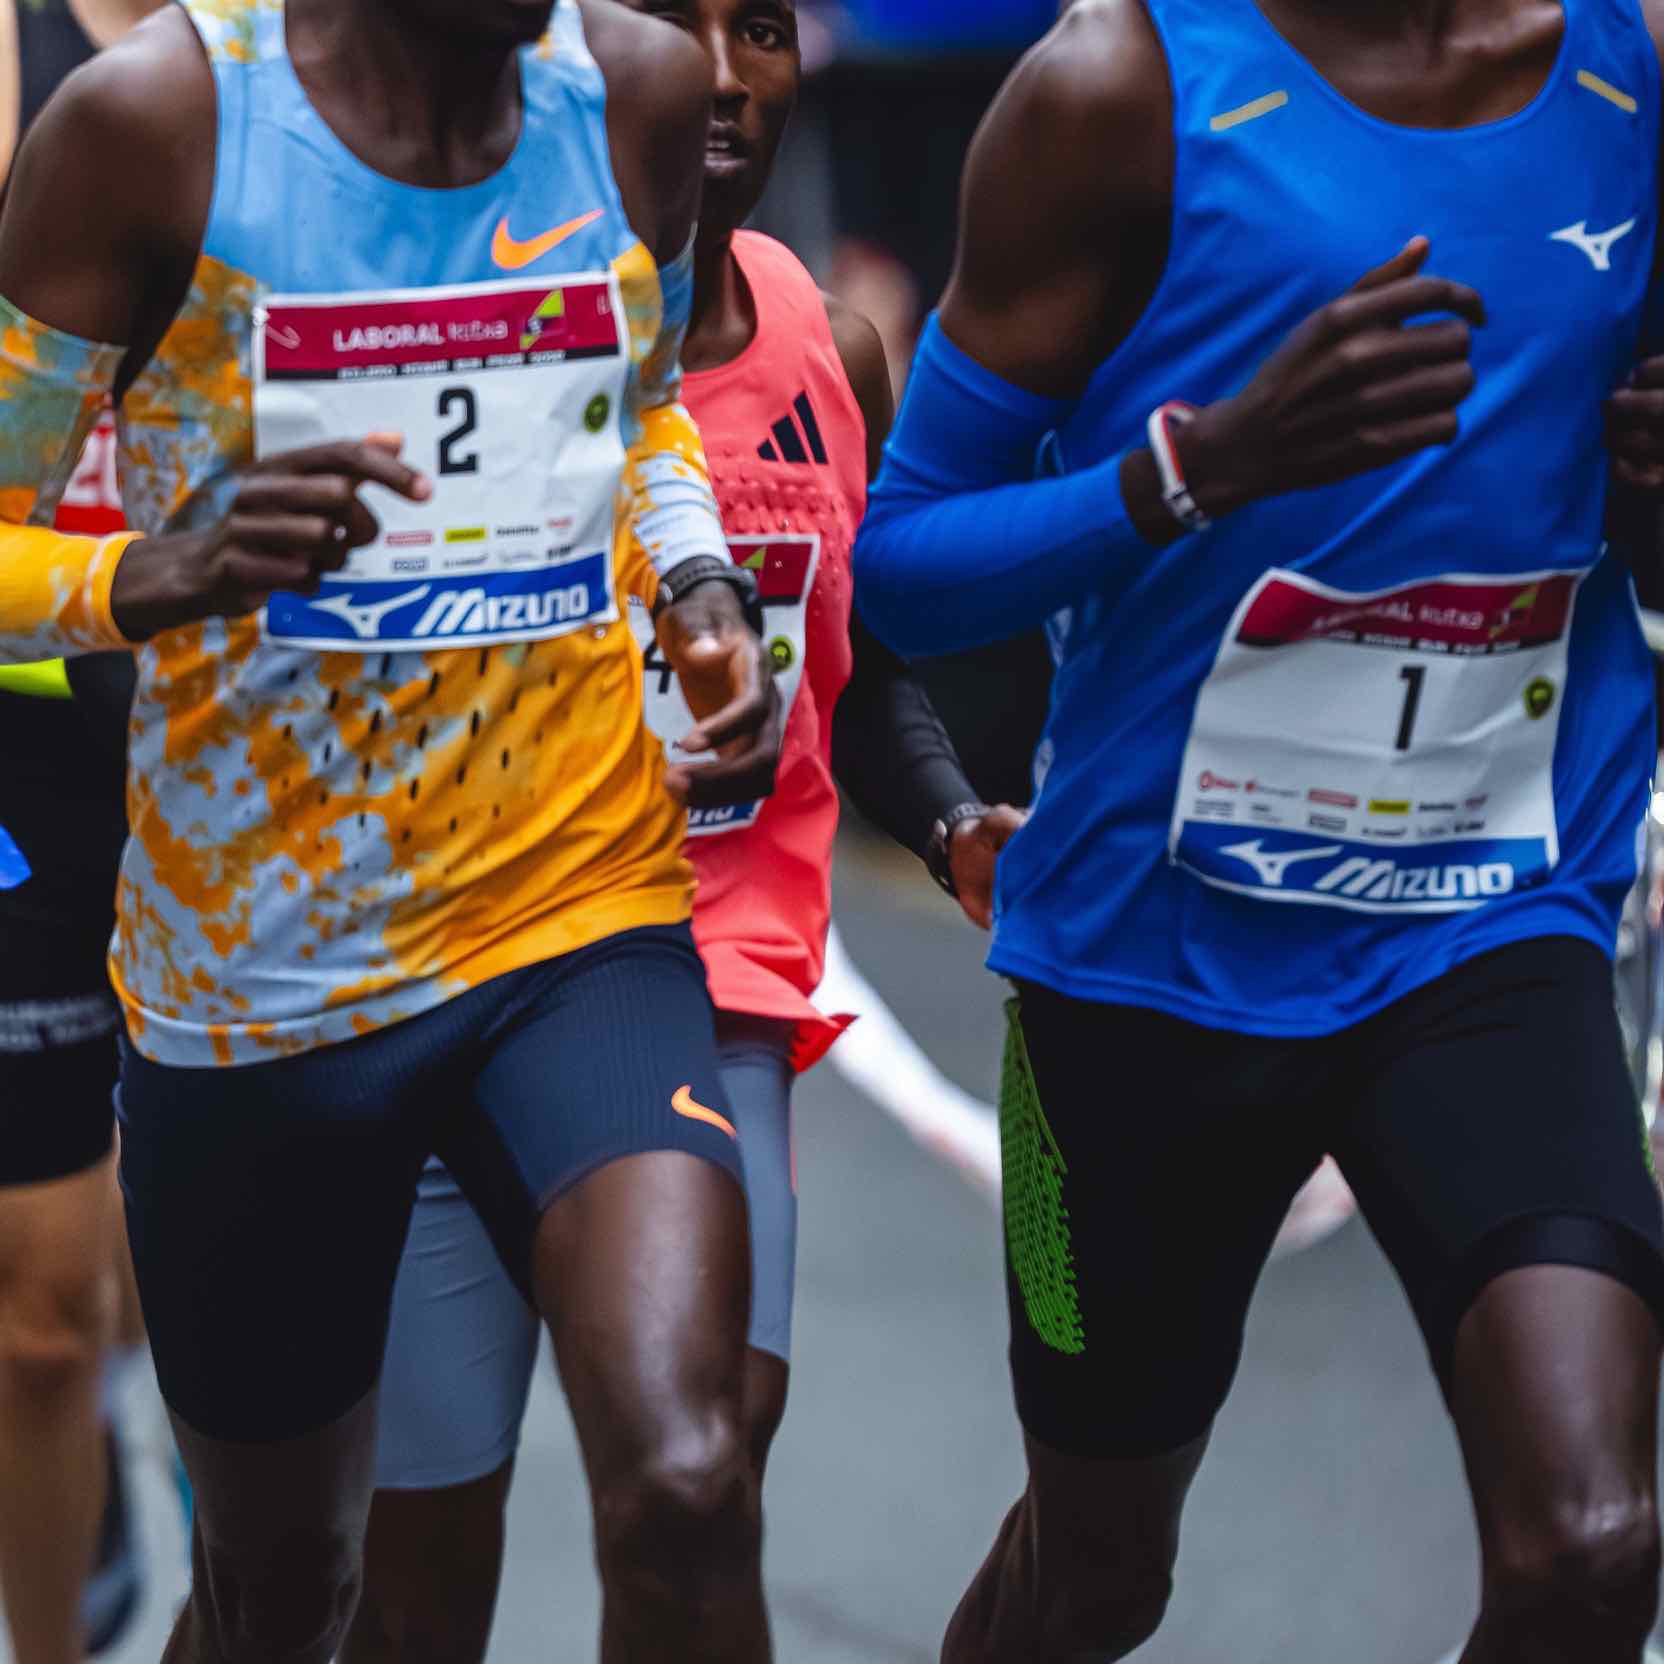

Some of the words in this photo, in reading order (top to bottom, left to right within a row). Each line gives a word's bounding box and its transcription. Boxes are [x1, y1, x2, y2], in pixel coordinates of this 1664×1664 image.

[333, 322, 445, 352] LABORAL
[439, 386, 478, 475] 2
[1394, 664, 1426, 752] 1
